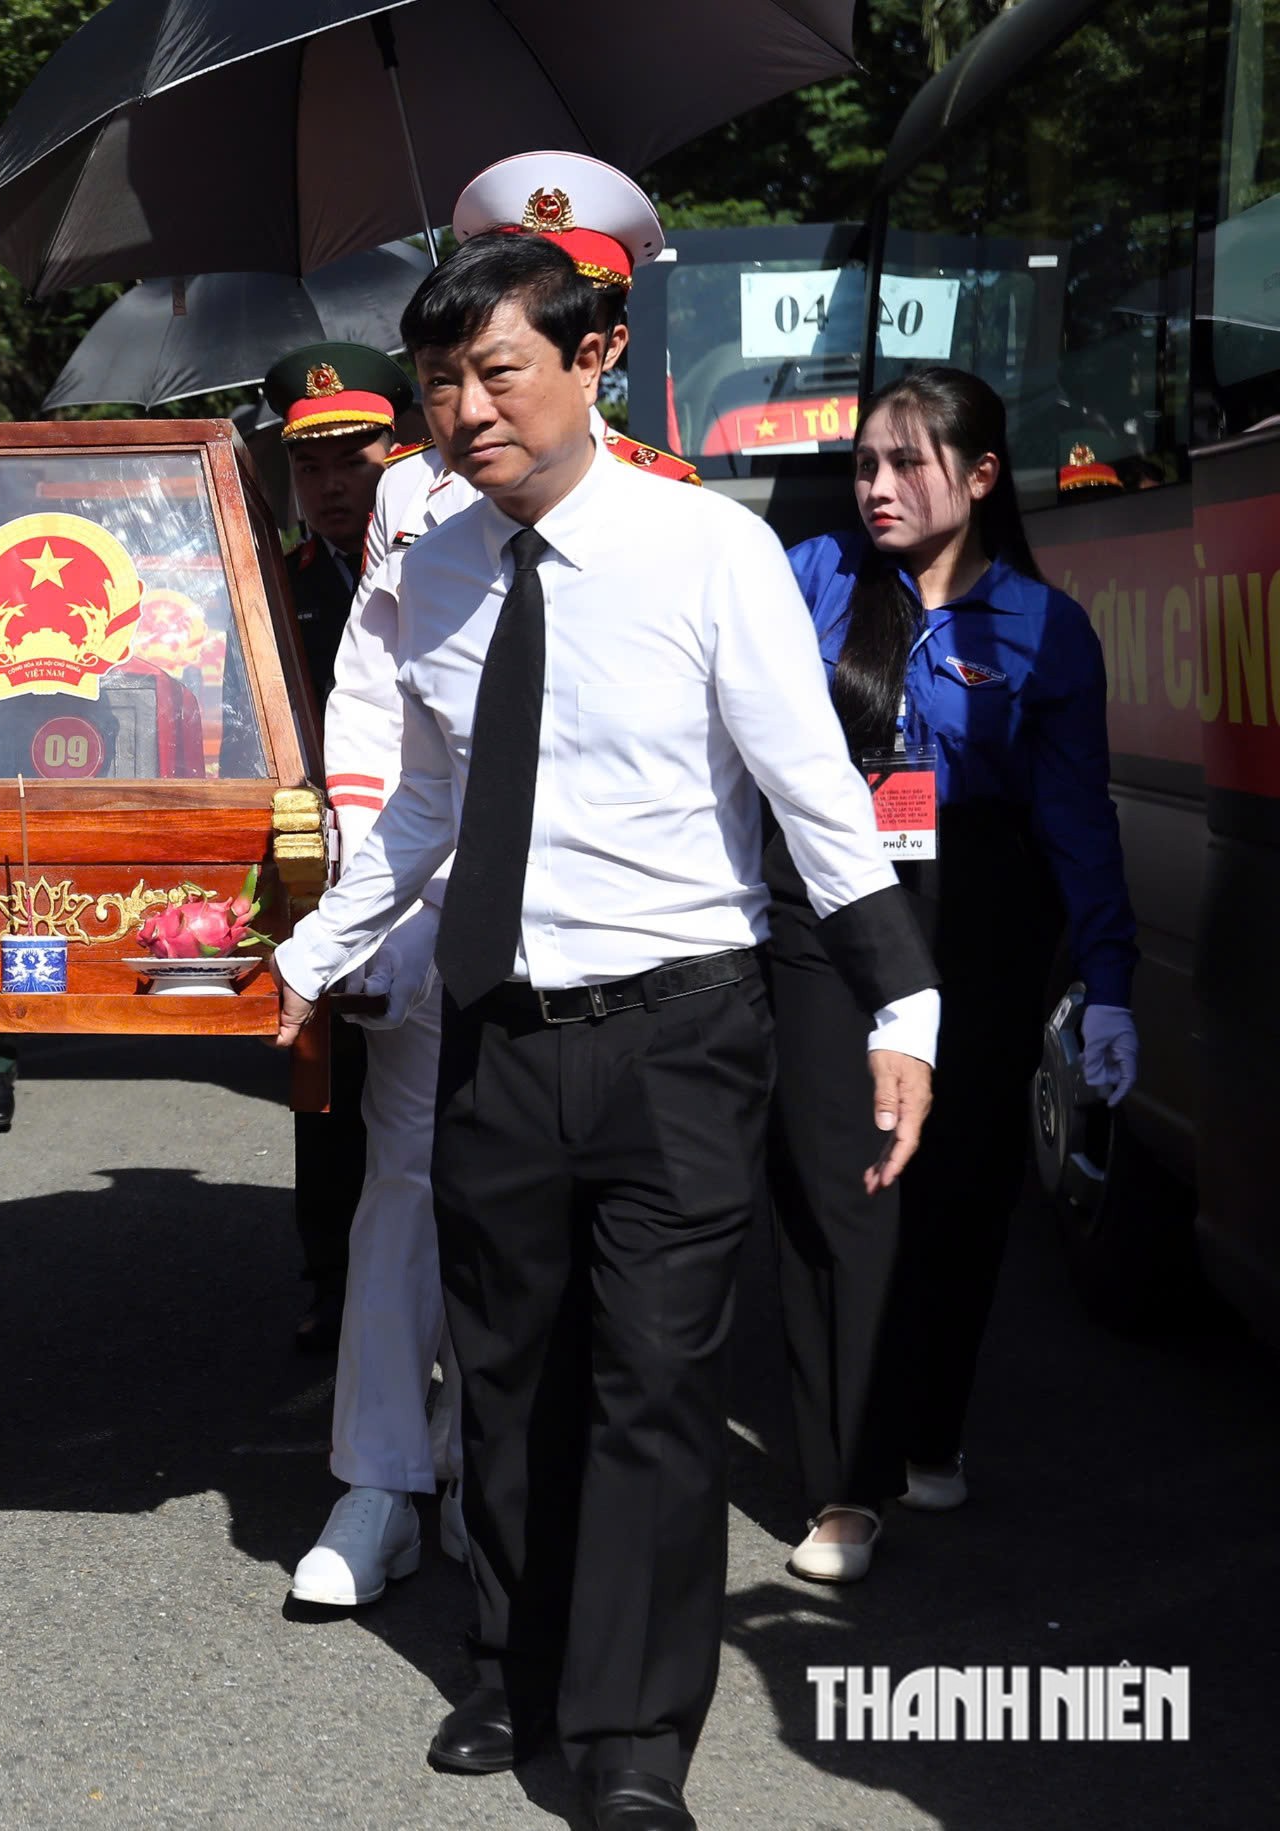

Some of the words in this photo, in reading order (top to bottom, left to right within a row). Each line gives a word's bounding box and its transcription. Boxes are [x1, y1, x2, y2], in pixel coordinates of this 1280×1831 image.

[775, 294, 829, 333] 04
[803, 397, 839, 436] TỔ
[1163, 544, 1280, 728] CÙN
[46, 668, 65, 678] NAM
[45, 734, 88, 768] 09
